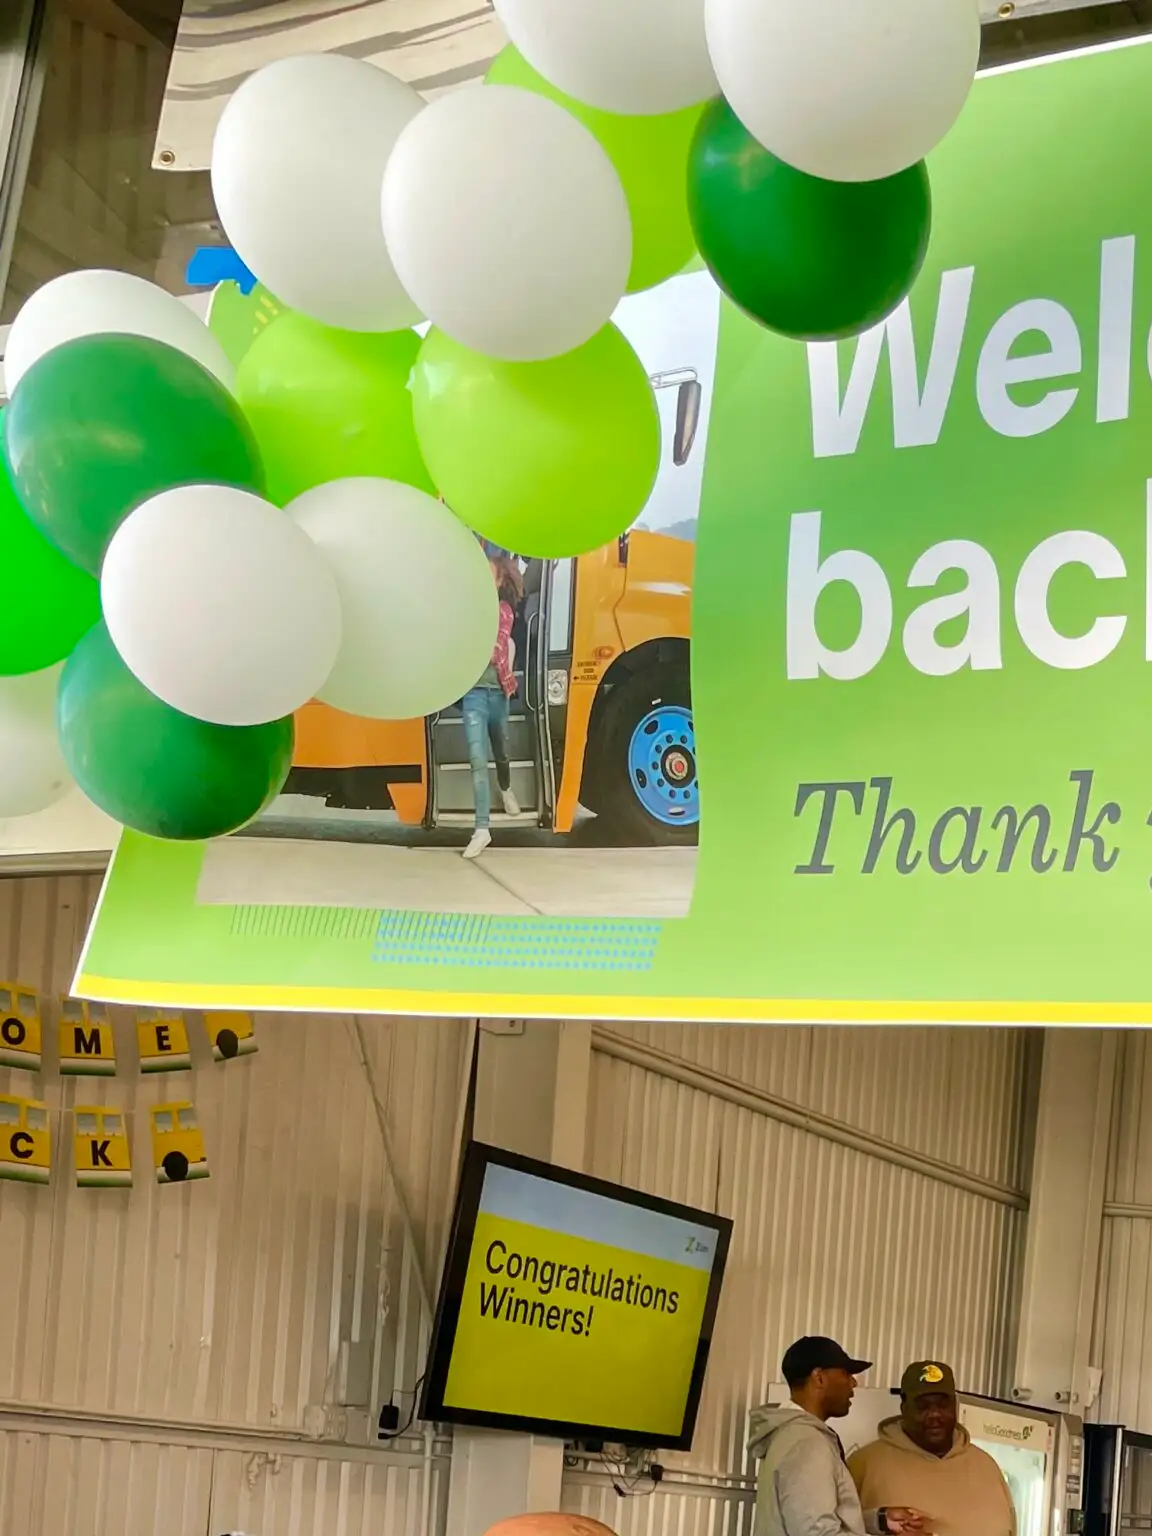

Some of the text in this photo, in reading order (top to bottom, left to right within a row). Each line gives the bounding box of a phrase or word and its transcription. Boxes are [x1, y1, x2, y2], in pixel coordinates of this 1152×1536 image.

[794, 769, 1122, 875] Thank
[479, 1282, 595, 1337] Winners!
[485, 1240, 680, 1315] Congratulations
